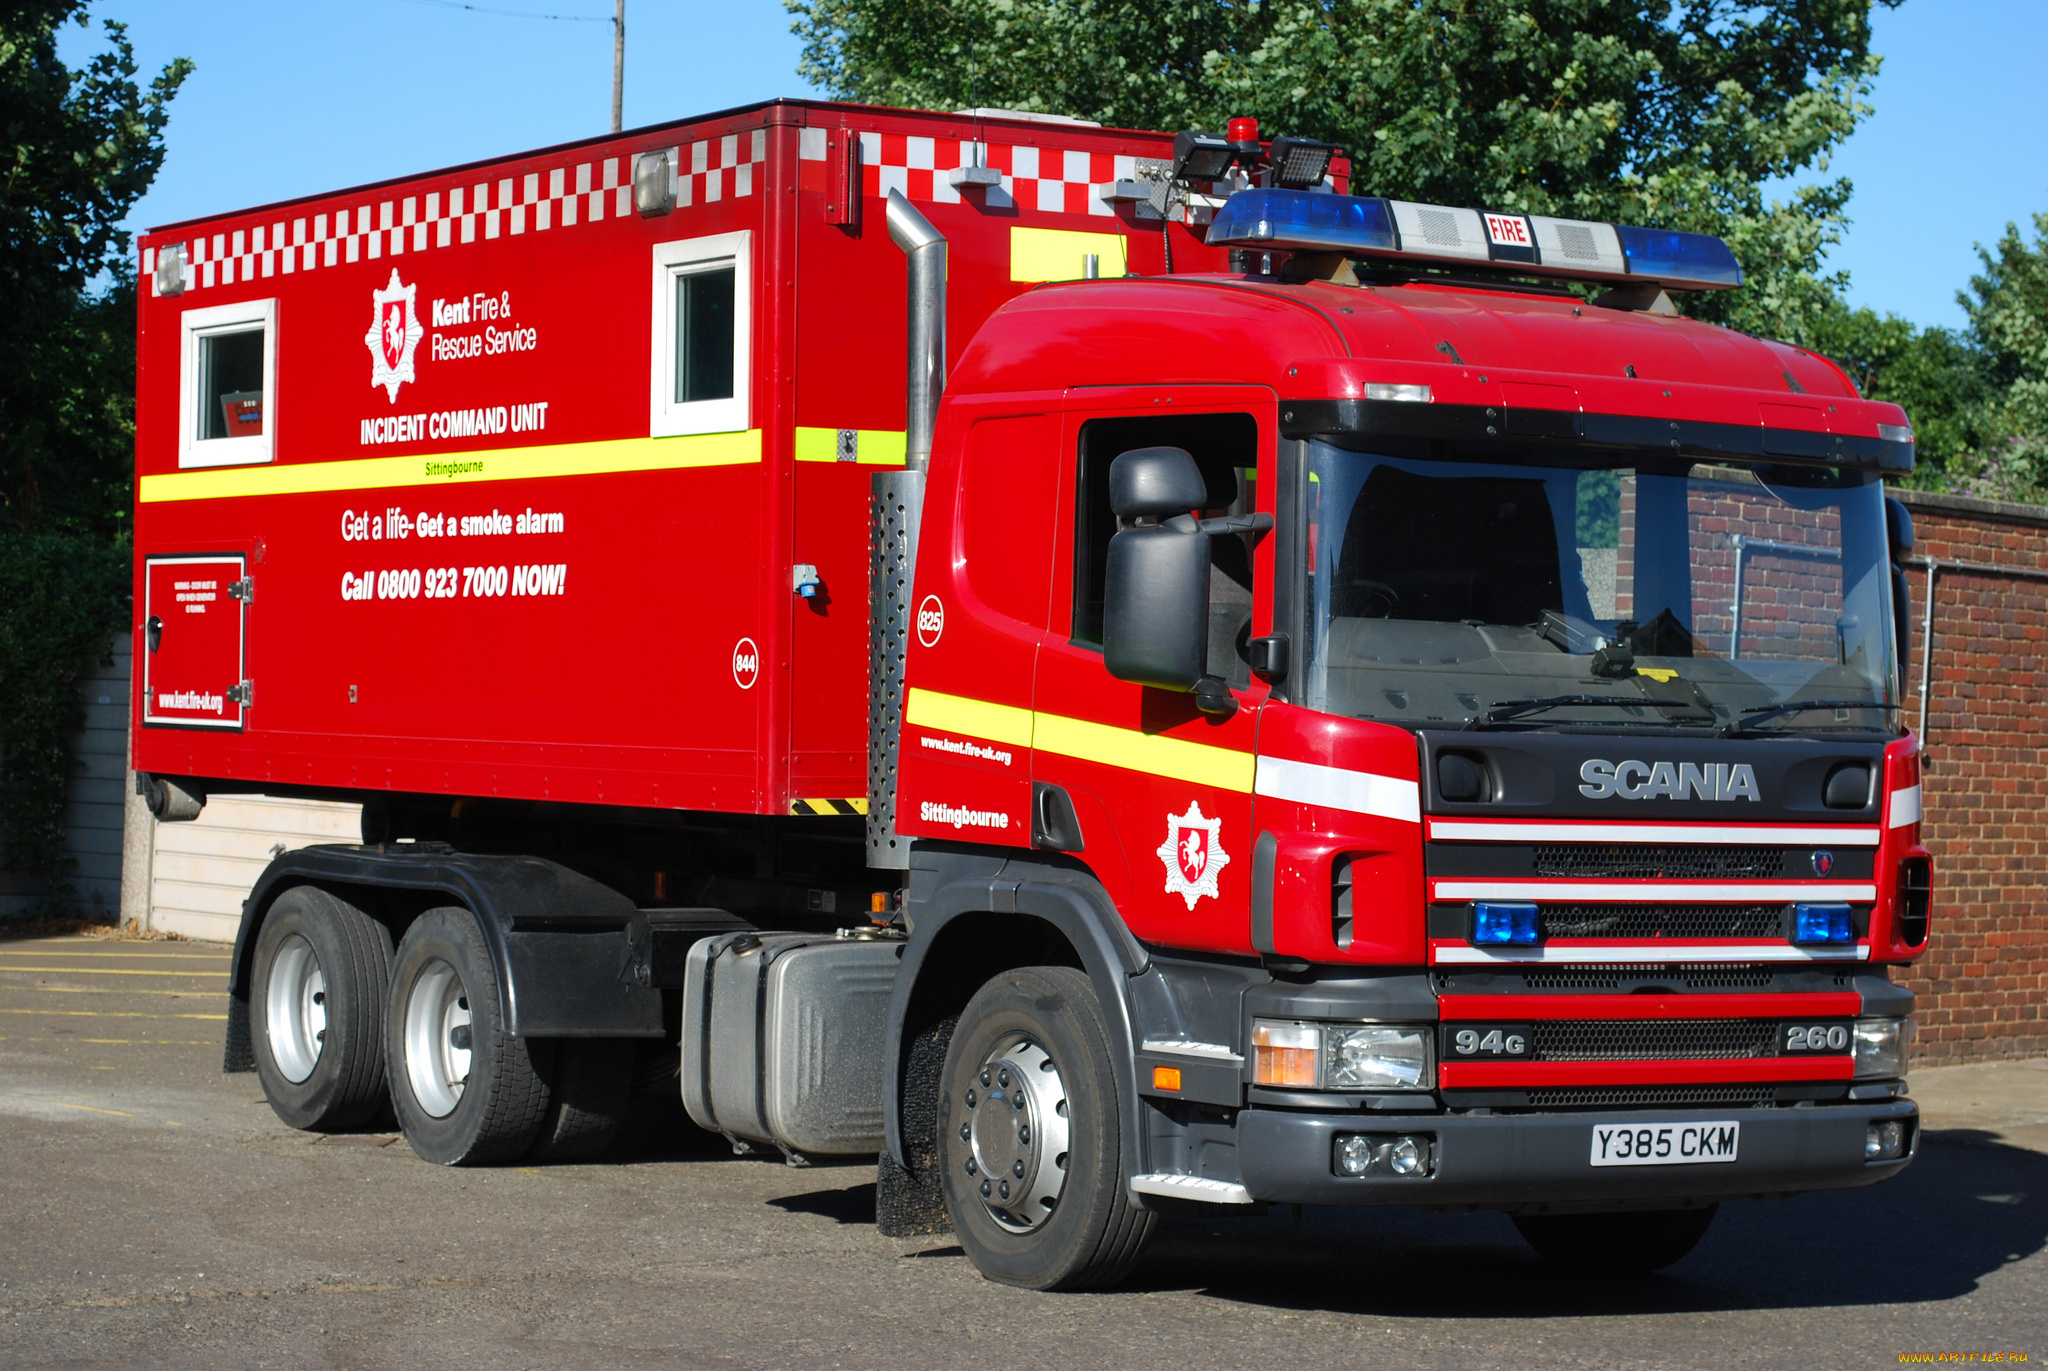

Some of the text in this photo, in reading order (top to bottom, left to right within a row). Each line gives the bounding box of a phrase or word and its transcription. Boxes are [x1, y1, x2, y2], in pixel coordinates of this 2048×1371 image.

[1488, 217, 1527, 242] FIRE
[432, 290, 511, 327] Kent Fire &
[432, 322, 537, 361] Rescue Service
[360, 401, 549, 445] INCIDENT COMMAND UNIT
[425, 460, 484, 478] Sittingbourne
[341, 509, 369, 541] Get
[372, 516, 382, 540] a
[446, 516, 457, 537] a
[460, 508, 512, 536] smoke
[515, 507, 564, 534] alarm
[341, 564, 567, 601] Call 0800 923 7000 NOW!
[919, 610, 941, 633] 825
[735, 654, 756, 673] 844
[158, 690, 223, 715] www.kent.fire-uk.org
[920, 735, 1012, 766] www.kent.fire-uk.org
[1578, 758, 1761, 802] SCANIA
[920, 801, 1009, 830] Sittingbourne
[1455, 1029, 1525, 1055] 94G
[1786, 1026, 1848, 1051] 260
[1598, 1126, 1735, 1160] Y385 CKM
